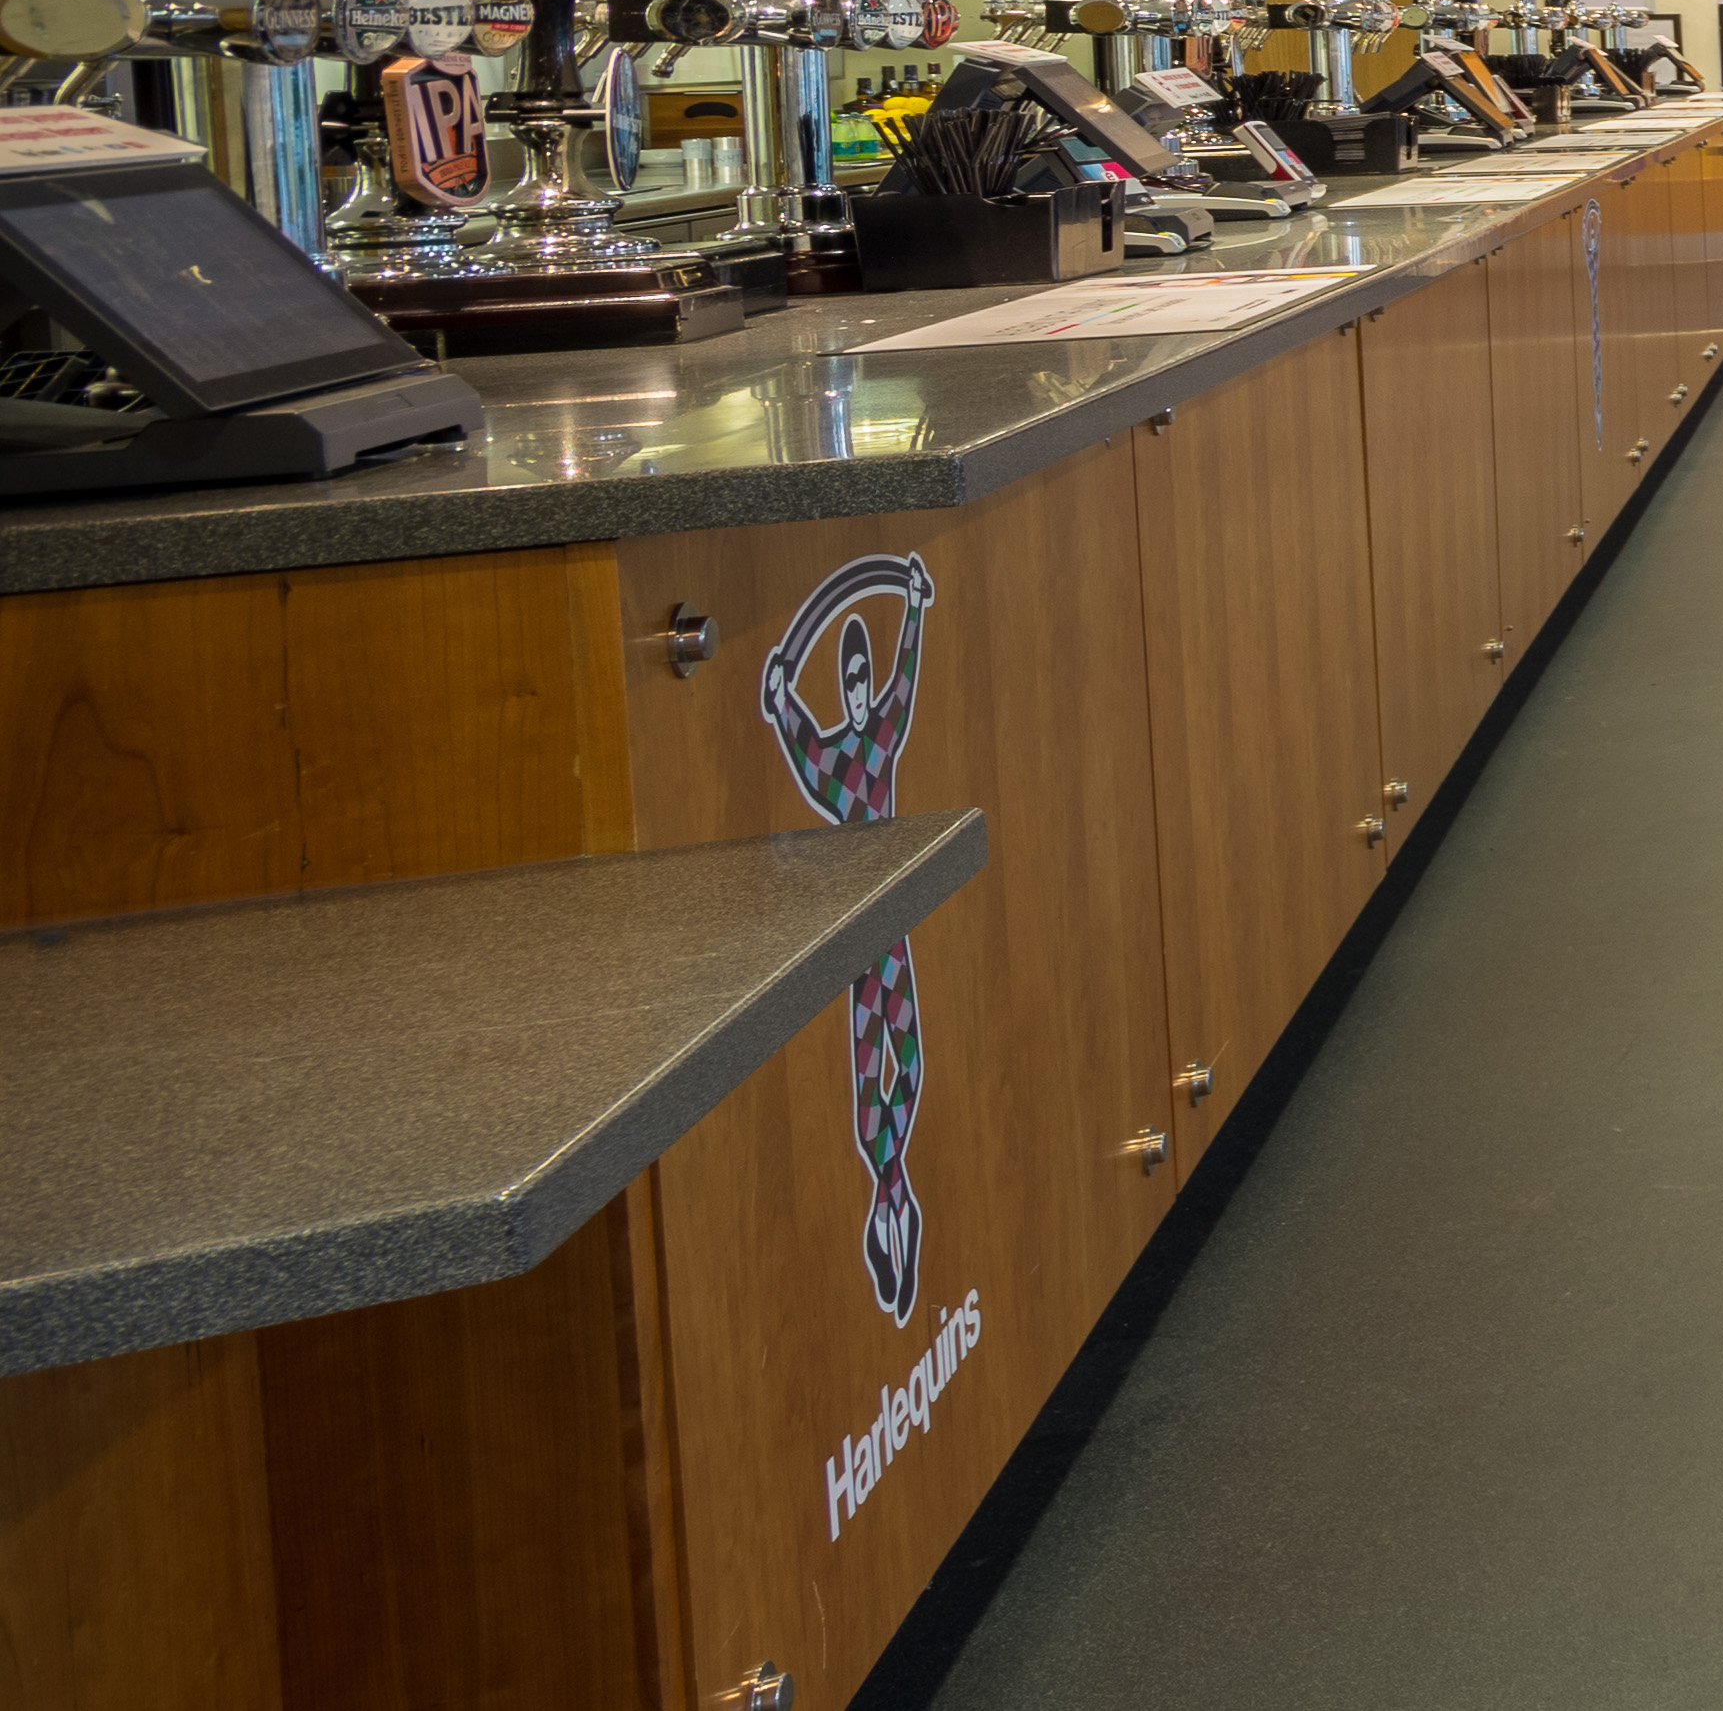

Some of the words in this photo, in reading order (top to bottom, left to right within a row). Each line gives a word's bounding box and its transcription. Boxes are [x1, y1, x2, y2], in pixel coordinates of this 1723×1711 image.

[264, 8, 317, 29] GUINNESS
[351, 10, 408, 27] Heineke
[408, 72, 485, 166] IPA
[825, 1286, 983, 1543] Harlequins
